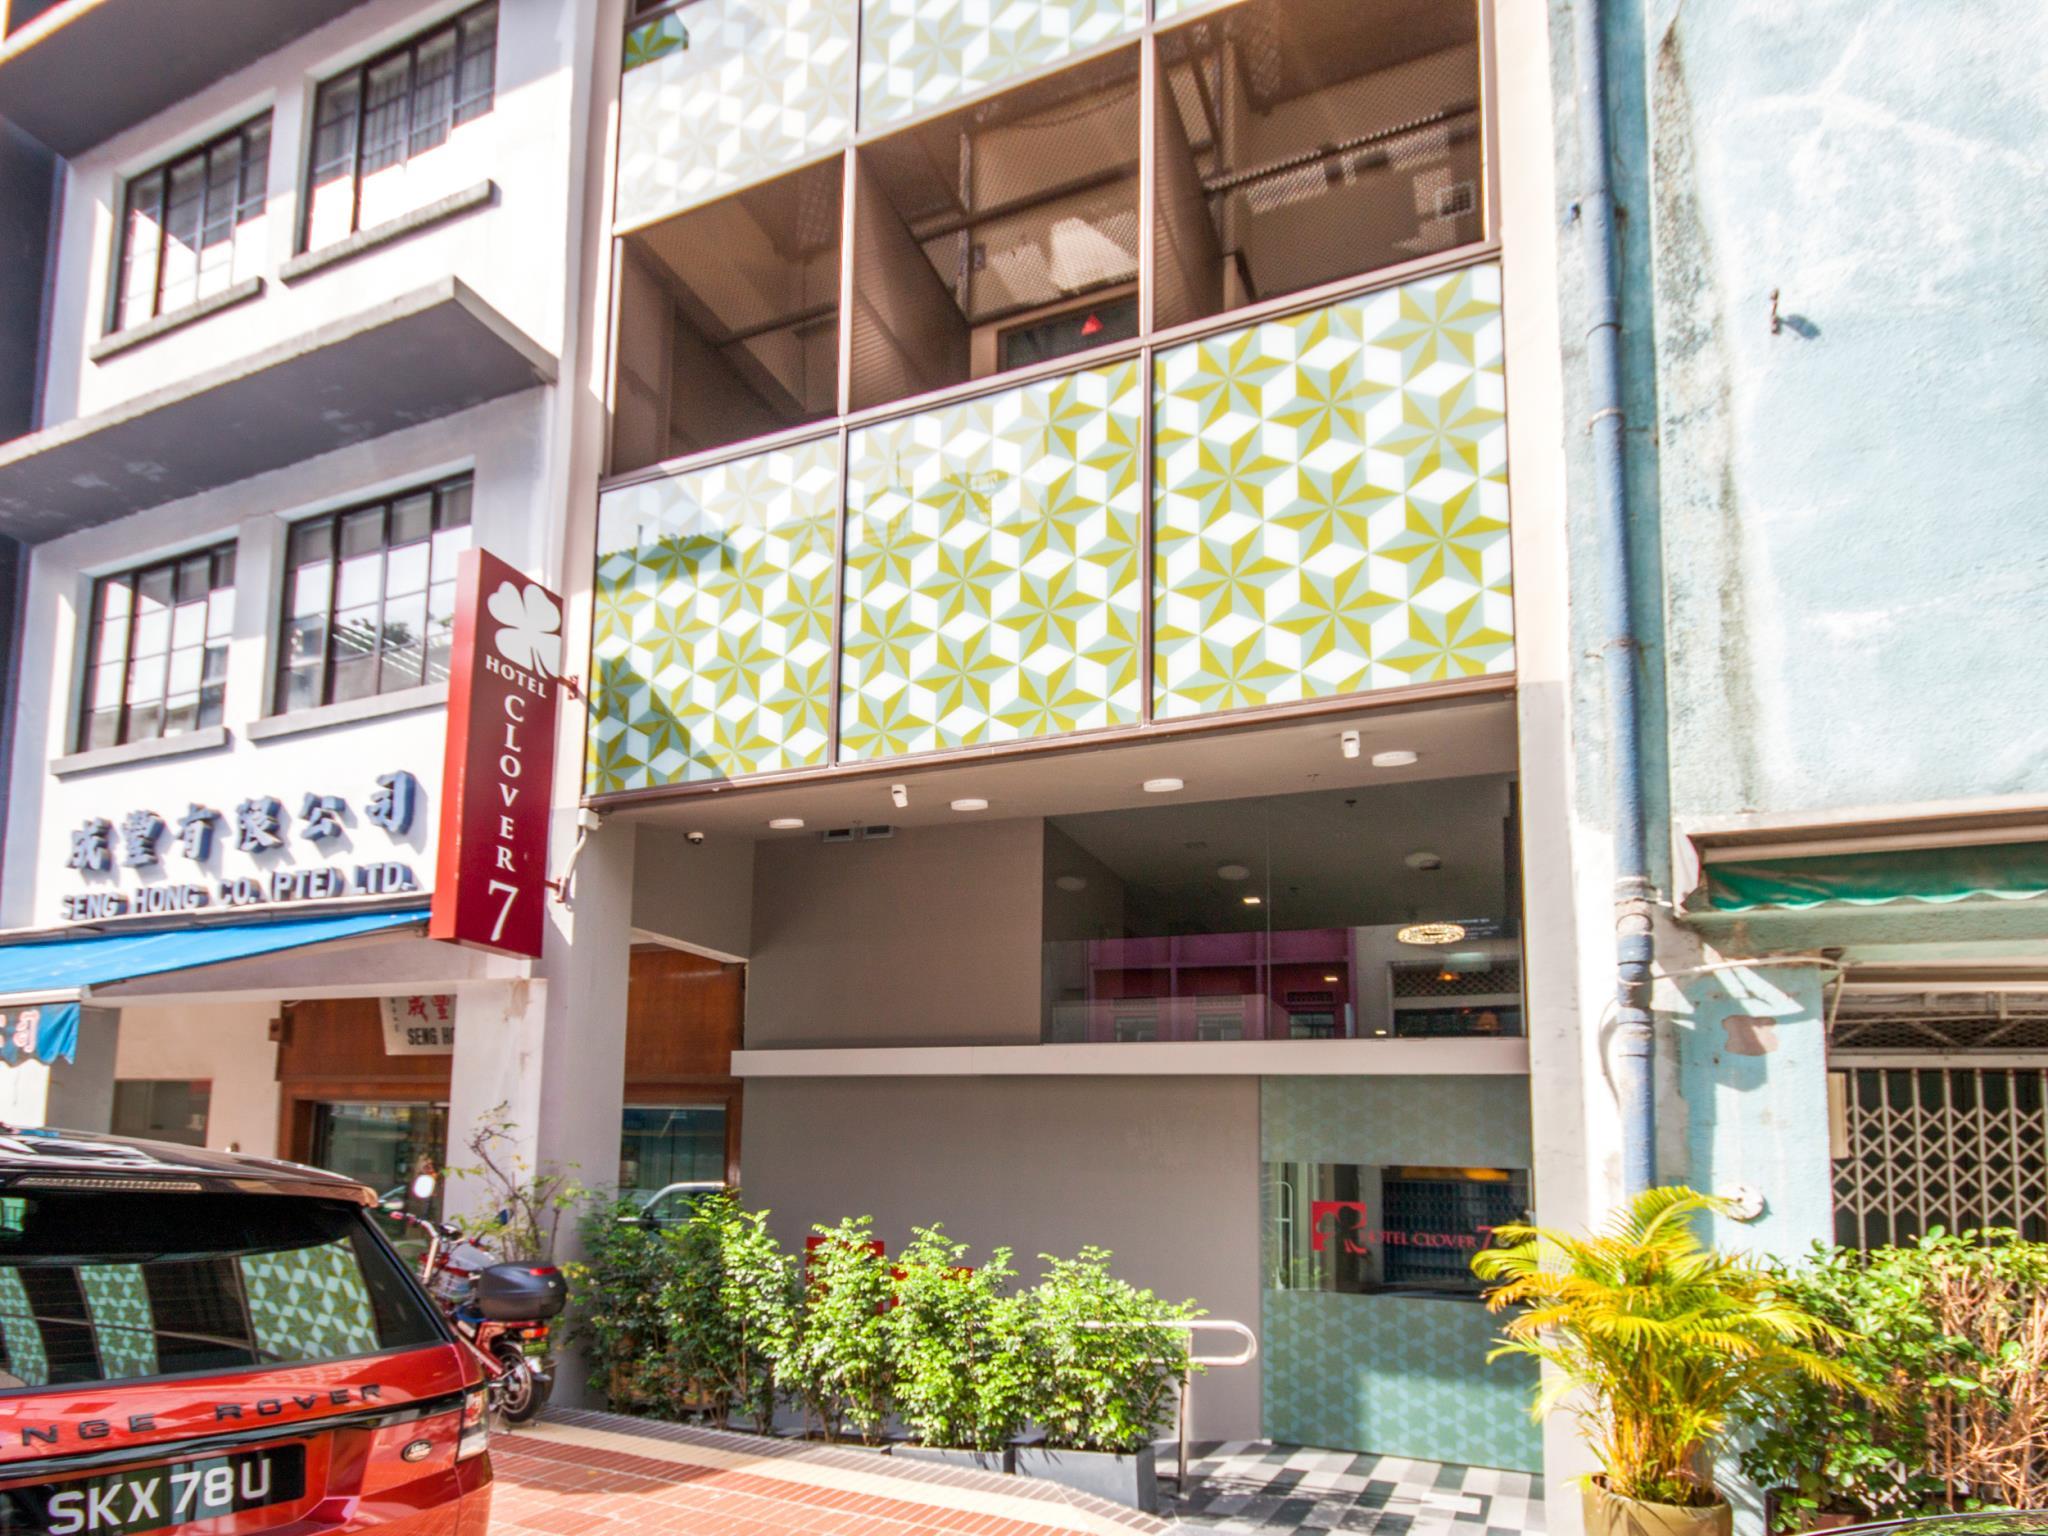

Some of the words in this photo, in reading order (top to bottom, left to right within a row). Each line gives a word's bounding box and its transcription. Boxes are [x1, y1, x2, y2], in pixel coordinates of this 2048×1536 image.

[486, 654, 547, 699] HOTEL
[496, 694, 525, 873] CLOVER
[63, 892, 126, 920] SENG
[132, 884, 210, 914] HONG
[219, 876, 259, 906] CO.
[271, 866, 343, 901] (PTE)
[352, 861, 417, 895] LTD.
[487, 878, 519, 942] 7
[1412, 1231, 1476, 1248] CLOVER
[0, 1413, 157, 1450] NGE
[214, 1384, 382, 1422] ROVER
